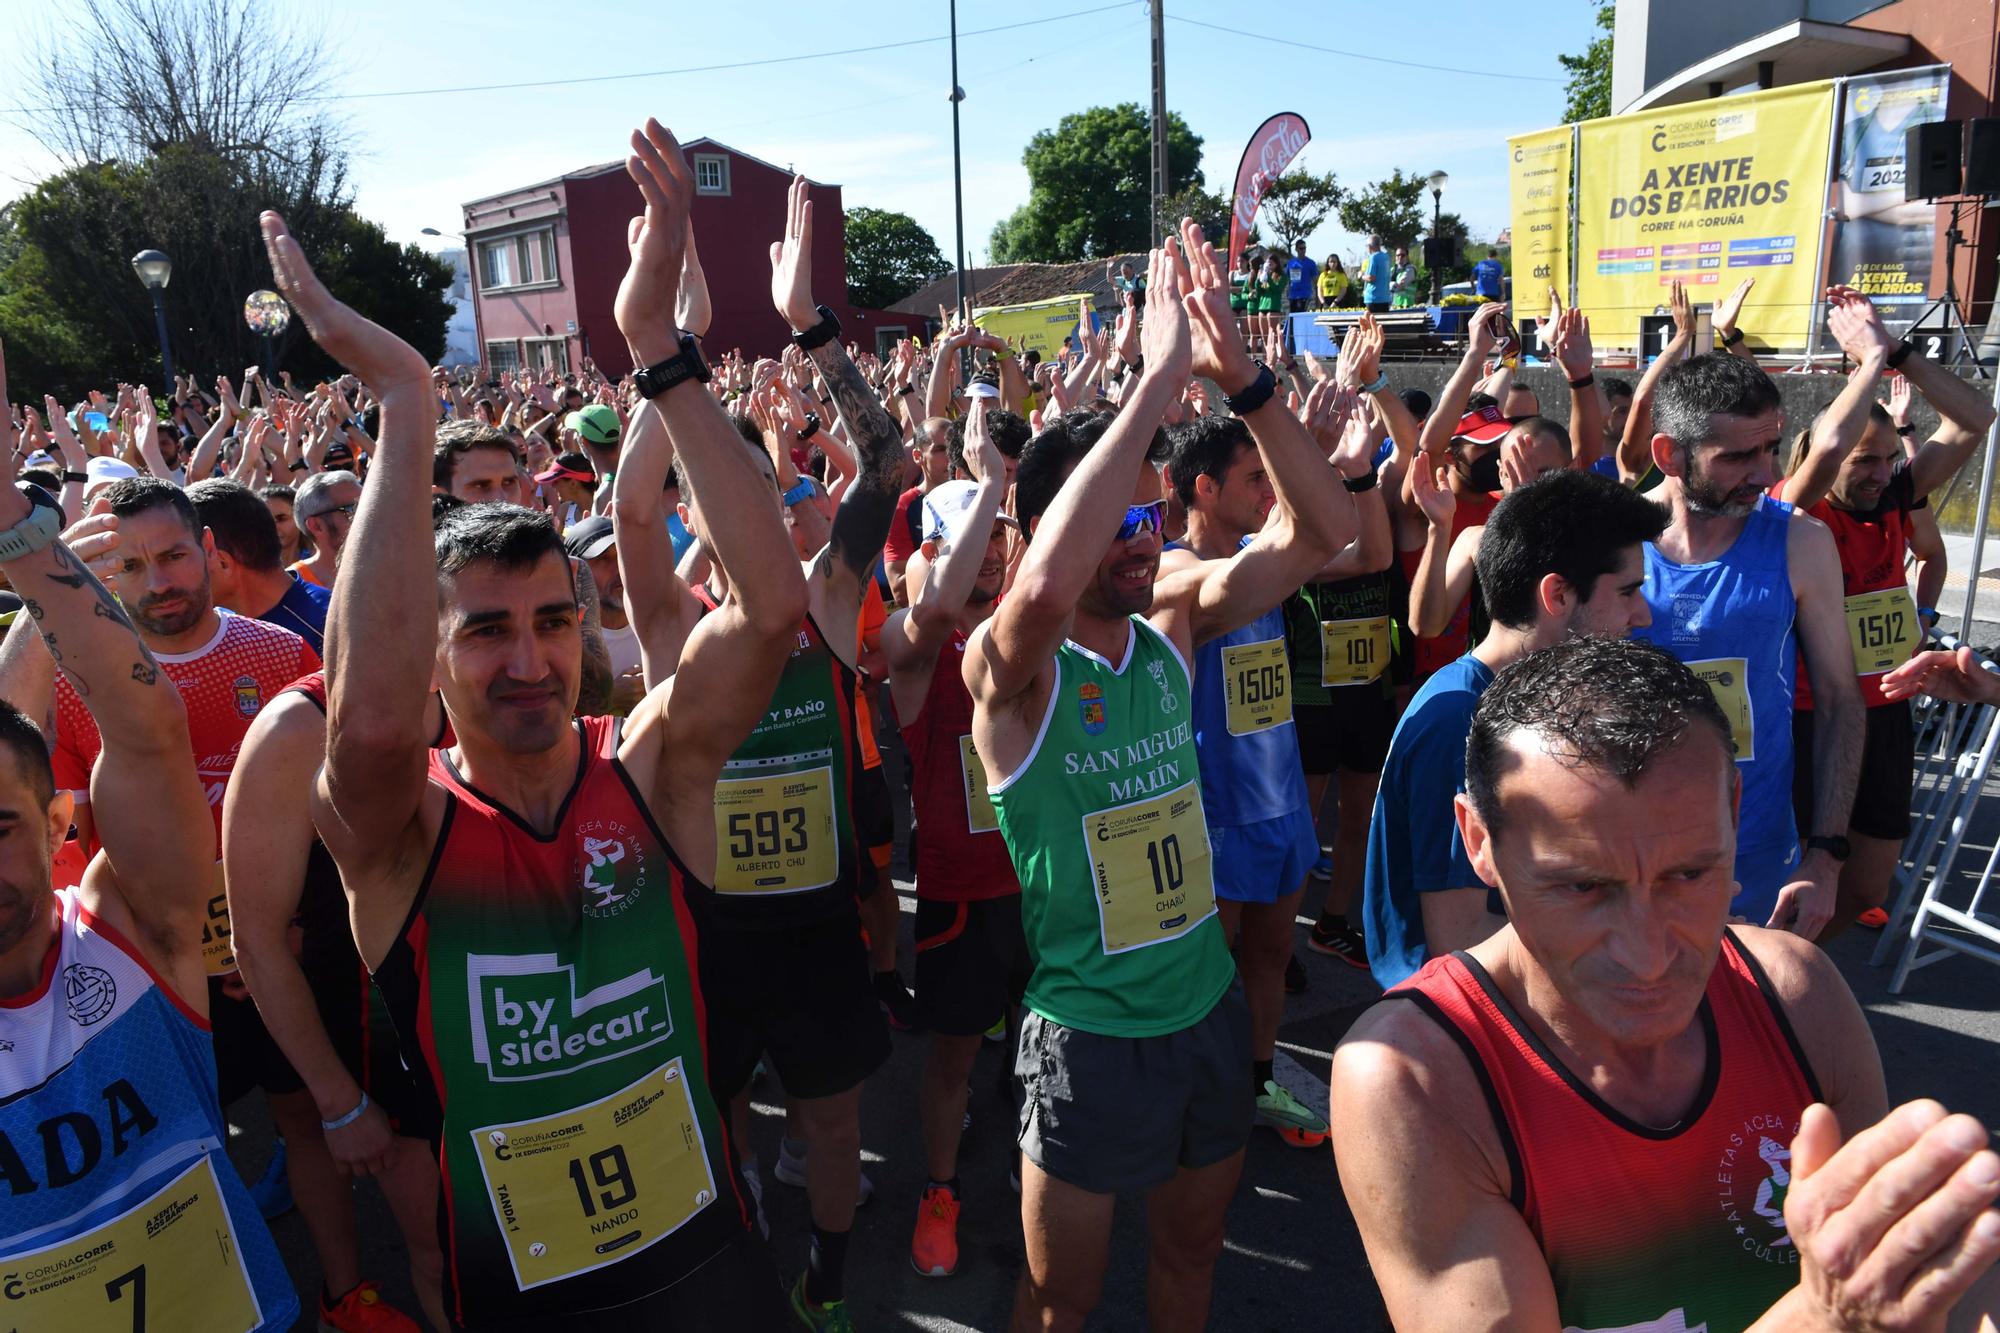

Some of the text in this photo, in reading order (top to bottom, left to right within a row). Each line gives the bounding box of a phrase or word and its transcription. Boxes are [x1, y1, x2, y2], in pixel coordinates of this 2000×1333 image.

[1234, 118, 1306, 230] Coca-Cola
[1641, 156, 1754, 192] A XENTE
[1610, 180, 1790, 220] DOS BARRIOS
[1530, 223, 1553, 233] GADIS
[1641, 221, 1675, 233] CORRE
[1697, 213, 1744, 229] CORUÑA
[1850, 272, 1908, 284] A XENTE
[1882, 263, 1905, 271] MAIO
[1861, 283, 1924, 295] BARRIOS
[1658, 325, 1669, 351] 1
[1926, 337, 1941, 359] 2
[1859, 611, 1906, 649] 1512
[1346, 638, 1375, 665] 101
[1239, 664, 1284, 705] 1505
[770, 699, 825, 722] Y BAÑO
[1064, 720, 1192, 775] SAN MIGUEL
[728, 807, 808, 858] 593
[1109, 810, 1160, 829] CORUÑACORRE
[1117, 829, 1138, 838] EDICIÓN
[609, 821, 627, 836] DE
[627, 835, 645, 864] AMA
[736, 857, 806, 872] ALBERTO CHU
[1147, 833, 1184, 895] 10
[1097, 861, 1110, 897] TANDA
[582, 877, 646, 918] CULLEREDO
[202, 943, 227, 957] FRAN
[495, 987, 556, 1036] by
[614, 1111, 632, 1124] DOS
[633, 1089, 665, 1114] BARRIOS
[621, 1095, 645, 1114] XENTE
[511, 1124, 585, 1146] CORUÑACORRE
[1744, 1114, 1785, 1137] ACEA
[523, 1146, 552, 1157] EDICIÓN
[553, 1142, 570, 1151] 2022
[569, 1144, 637, 1218] 19
[1718, 1133, 1744, 1222] ATLETAS
[146, 1220, 153, 1229] A
[153, 1200, 179, 1222] XENTE
[147, 1220, 165, 1235] DOS
[165, 1193, 199, 1226] BARRIOS
[497, 1184, 521, 1233] TANDA 1
[590, 1208, 639, 1235] NANDO
[25, 1240, 115, 1281] CORUÑACORRE
[1742, 1237, 1799, 1265] CULLE
[29, 1286, 39, 1295] IX
[40, 1273, 76, 1292] EDICIÓN
[76, 1265, 97, 1280] 2022
[105, 1264, 146, 1333] 7
